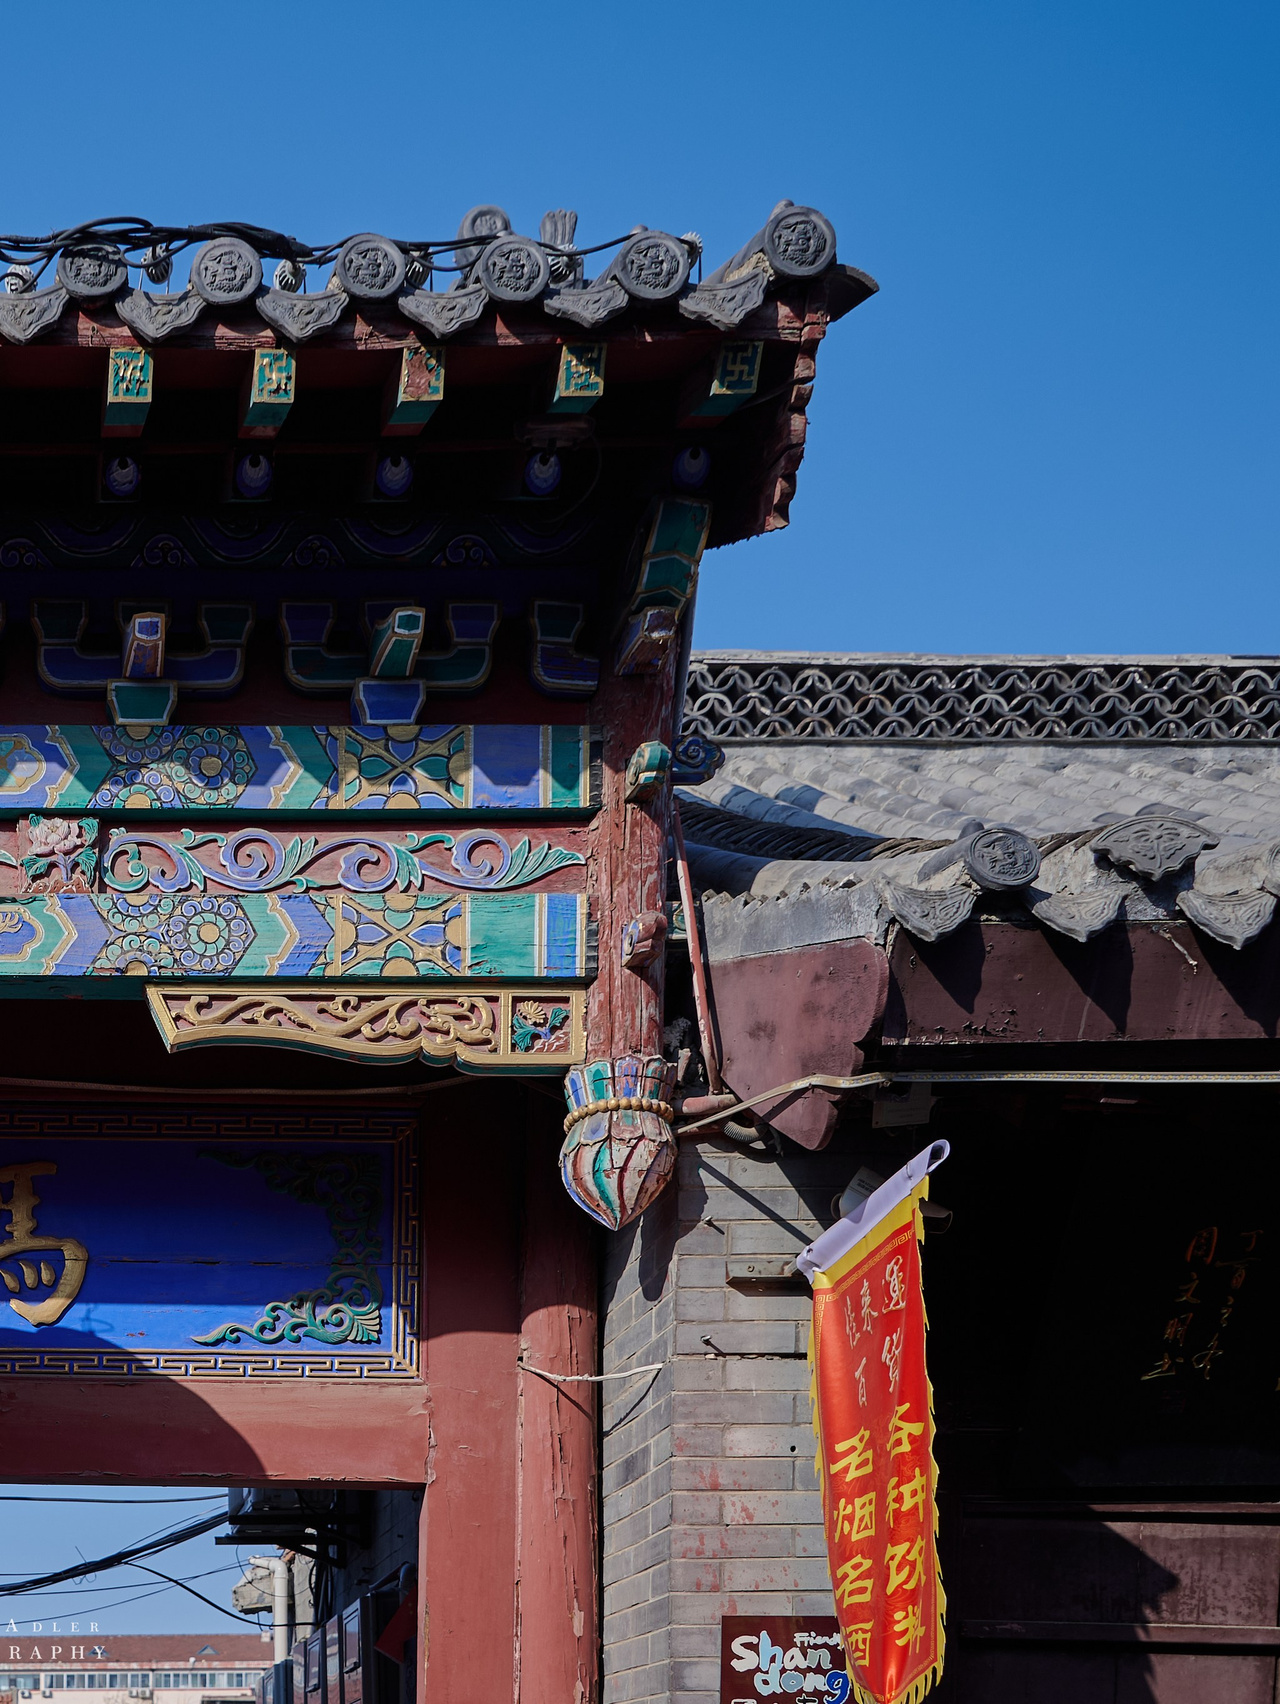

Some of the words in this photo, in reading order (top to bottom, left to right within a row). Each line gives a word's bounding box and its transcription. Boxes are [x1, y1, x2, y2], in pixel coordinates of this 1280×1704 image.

[829, 1426, 876, 1667] 名烟名酒
[884, 1402, 927, 1656] 各种饮料
[730, 1630, 833, 1673] Shan
[753, 1662, 850, 1704] dong
